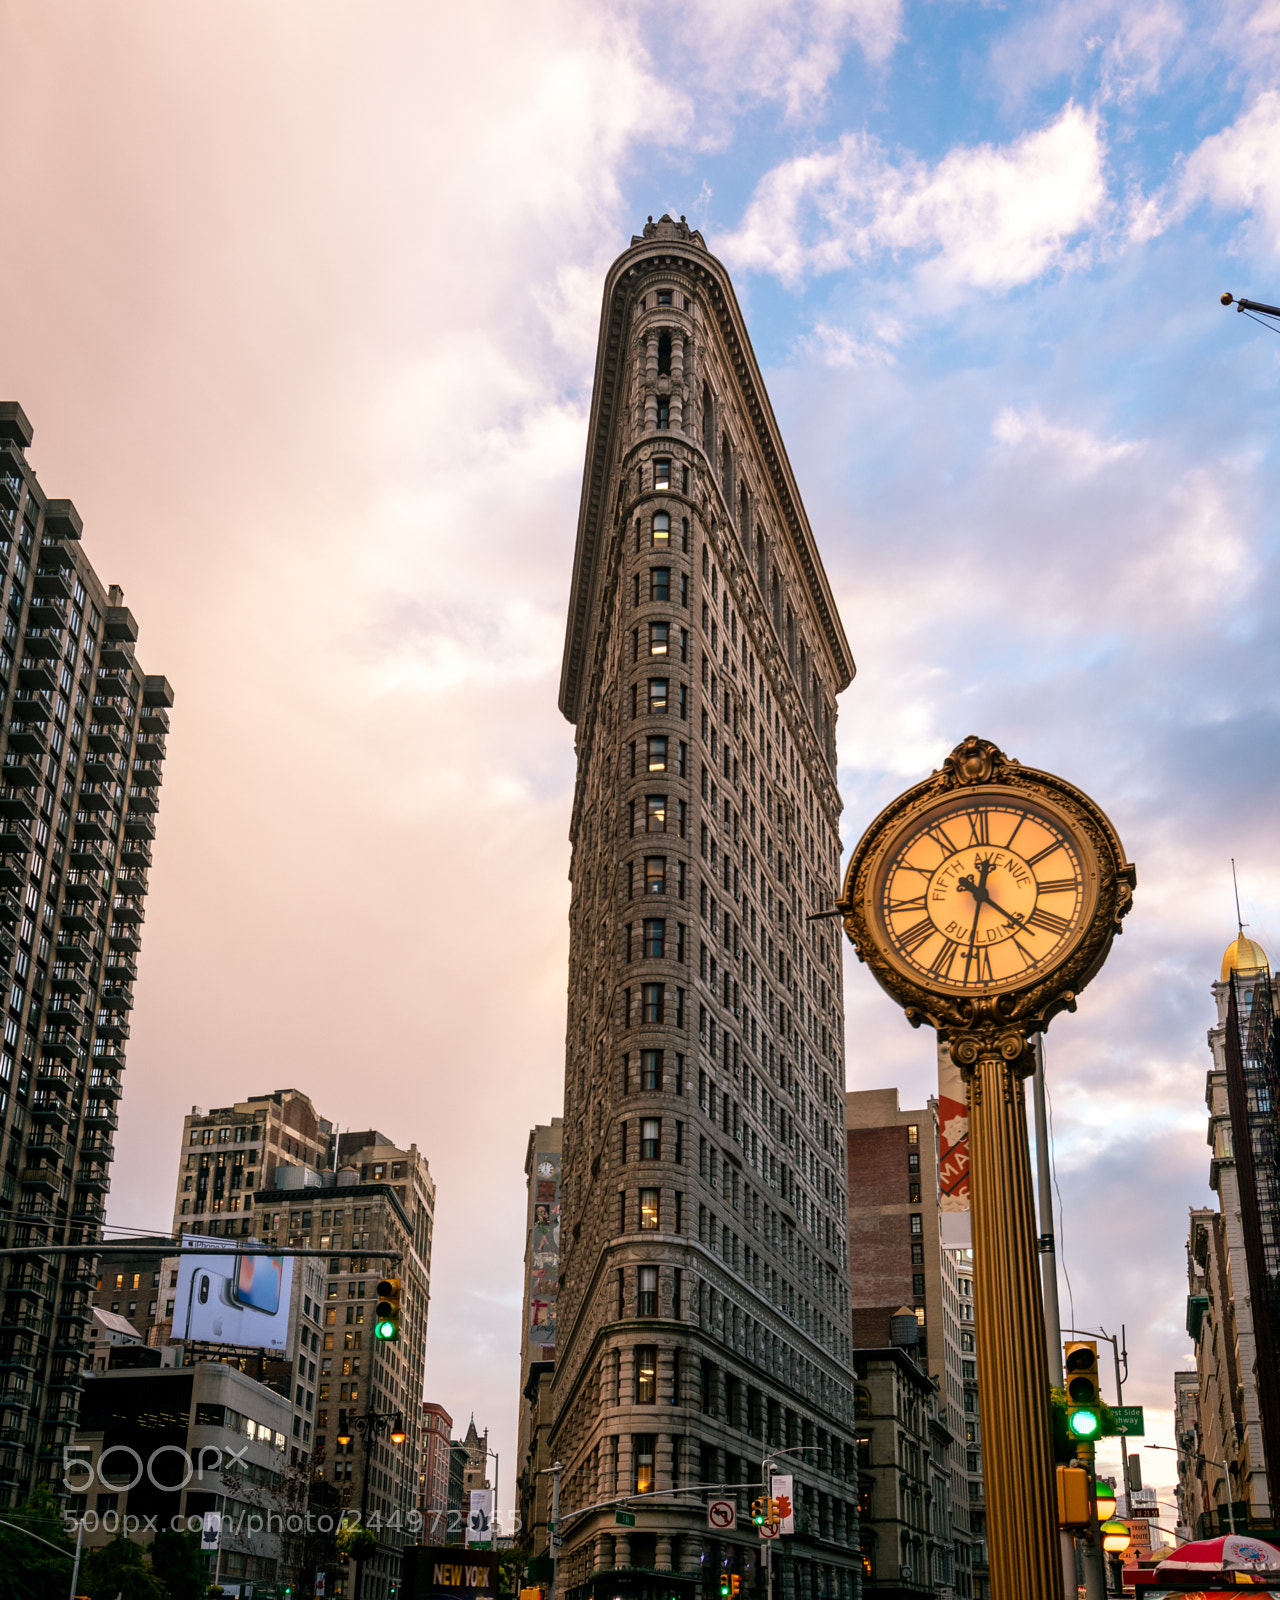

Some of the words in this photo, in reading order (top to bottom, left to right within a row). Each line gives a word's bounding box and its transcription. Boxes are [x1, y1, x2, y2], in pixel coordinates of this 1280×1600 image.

[932, 859, 965, 901] FIFTH
[974, 852, 1031, 889] AVENUE
[940, 1142, 970, 1185] MA
[1115, 1417, 1138, 1425] hway
[1124, 1408, 1140, 1416] Side
[433, 1563, 463, 1587] NEW
[465, 1565, 491, 1588] YORK
